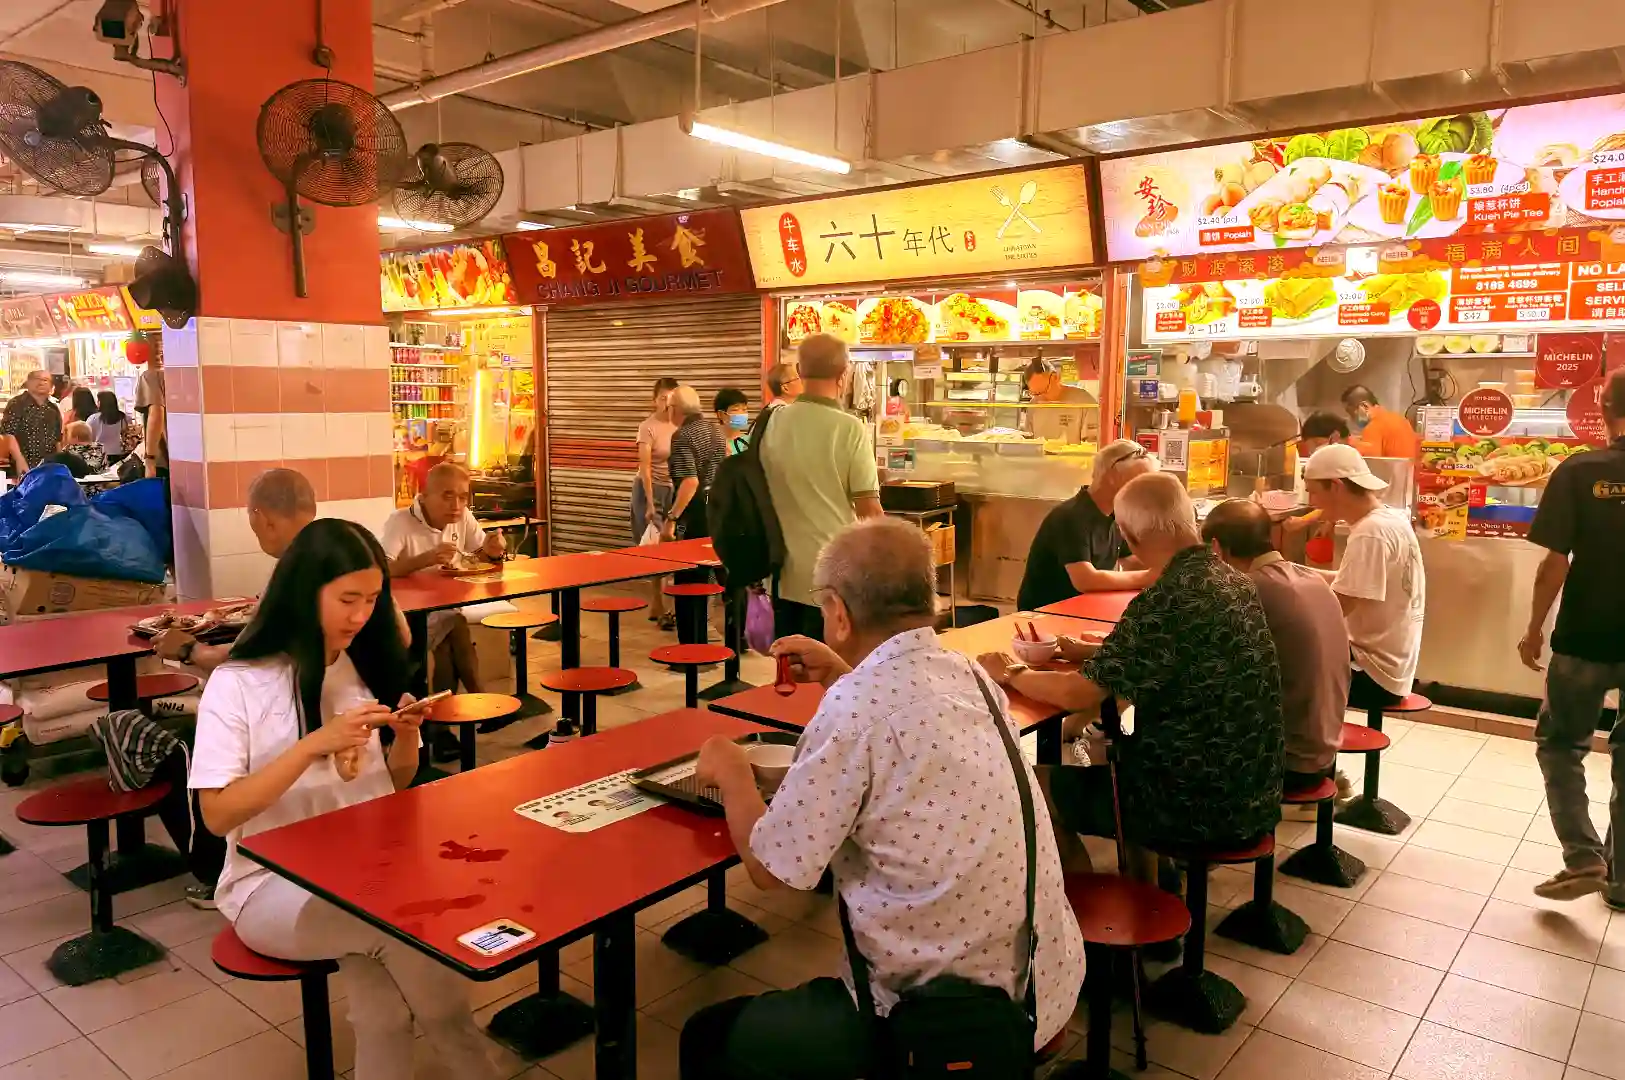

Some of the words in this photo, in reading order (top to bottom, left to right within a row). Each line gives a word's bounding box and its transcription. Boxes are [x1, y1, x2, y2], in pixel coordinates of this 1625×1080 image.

[1501, 181, 1530, 193] (4pcs)
[1134, 175, 1173, 219] 安珍
[1474, 212, 1501, 221] Kueh
[1503, 210, 1519, 219] Pie
[1522, 209, 1544, 217] Tee
[1223, 230, 1252, 241] Popiah
[532, 224, 706, 279] 昌記美食
[783, 217, 804, 274] 牛车水
[1445, 235, 1579, 261] 福满人间
[1578, 264, 1602, 276] NO
[537, 280, 600, 300] CHANG
[606, 279, 620, 295] JI
[624, 269, 724, 294] GOURMET
[1544, 353, 1593, 361] MICHELIN
[1556, 363, 1579, 371] 2025
[543, 790, 575, 803] CLEAN
[578, 782, 598, 792] AND
